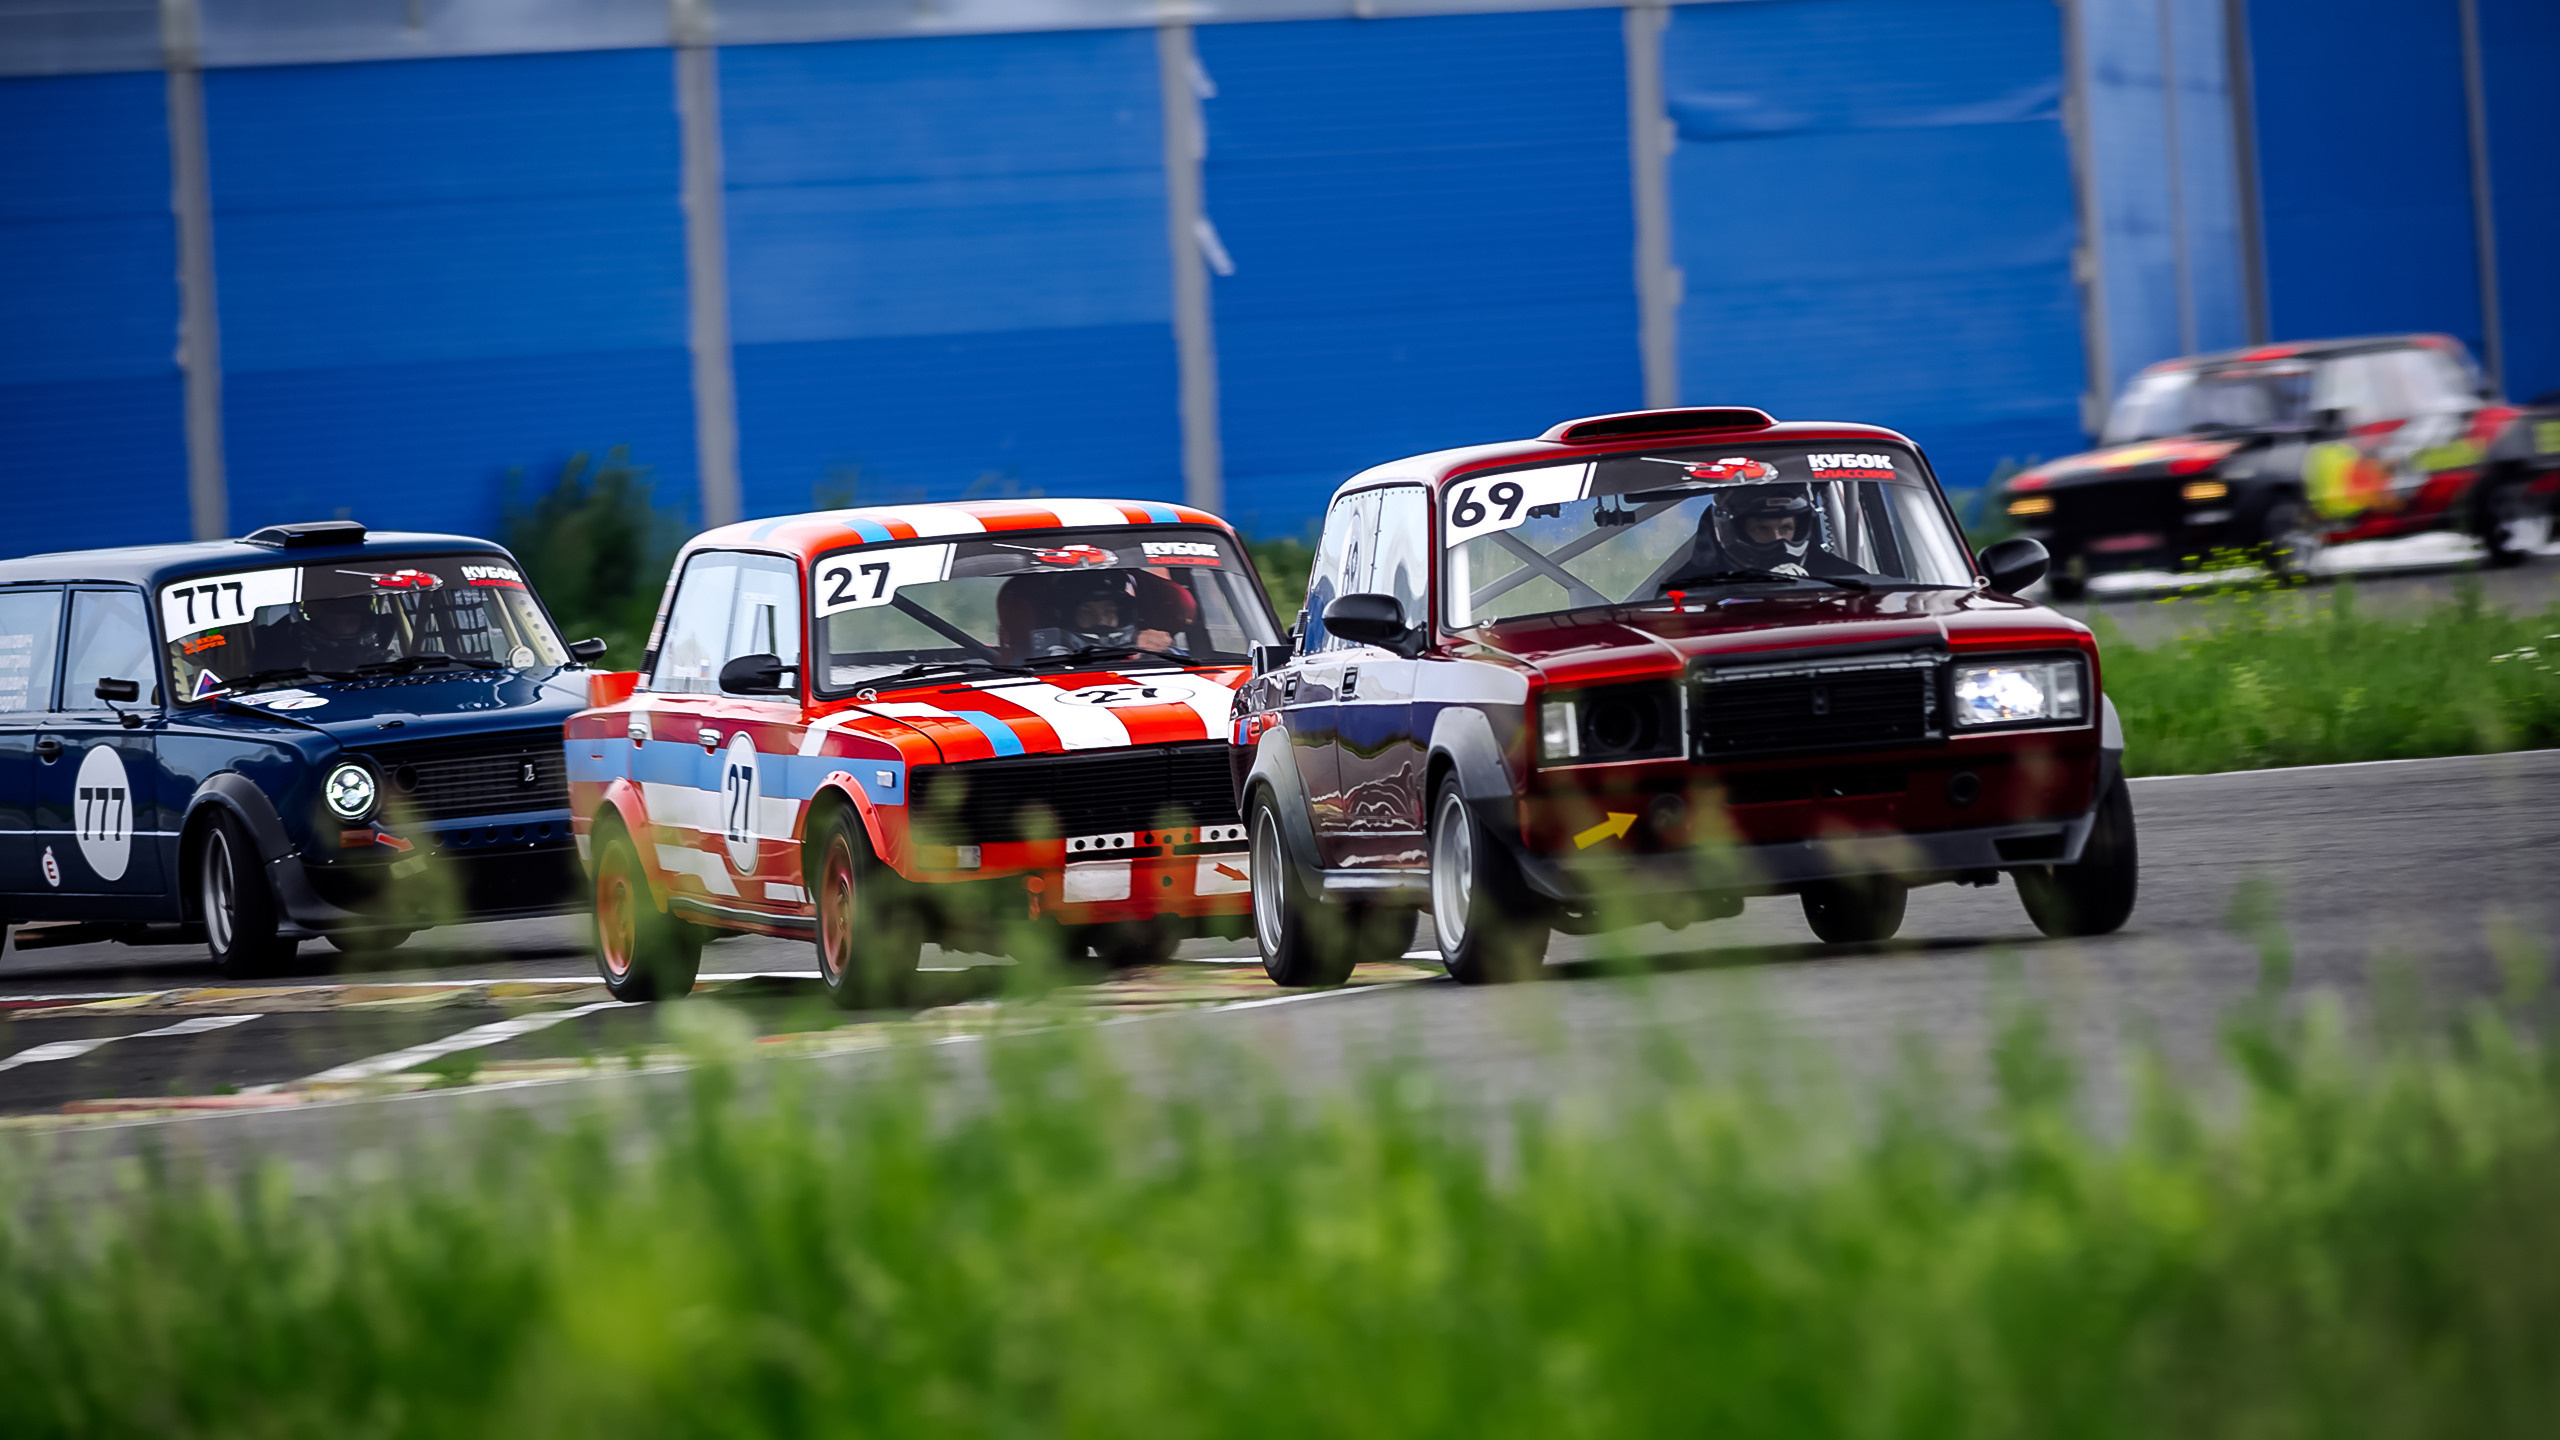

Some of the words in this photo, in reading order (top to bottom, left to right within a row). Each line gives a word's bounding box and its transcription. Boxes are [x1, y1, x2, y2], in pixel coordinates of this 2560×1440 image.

[1806, 453, 1894, 469] КУБОК
[1452, 482, 1524, 528] 69
[172, 581, 245, 625] 777
[823, 562, 890, 607] 27
[1075, 687, 1158, 704] 27
[80, 787, 126, 841] 777
[728, 763, 753, 844] 27
